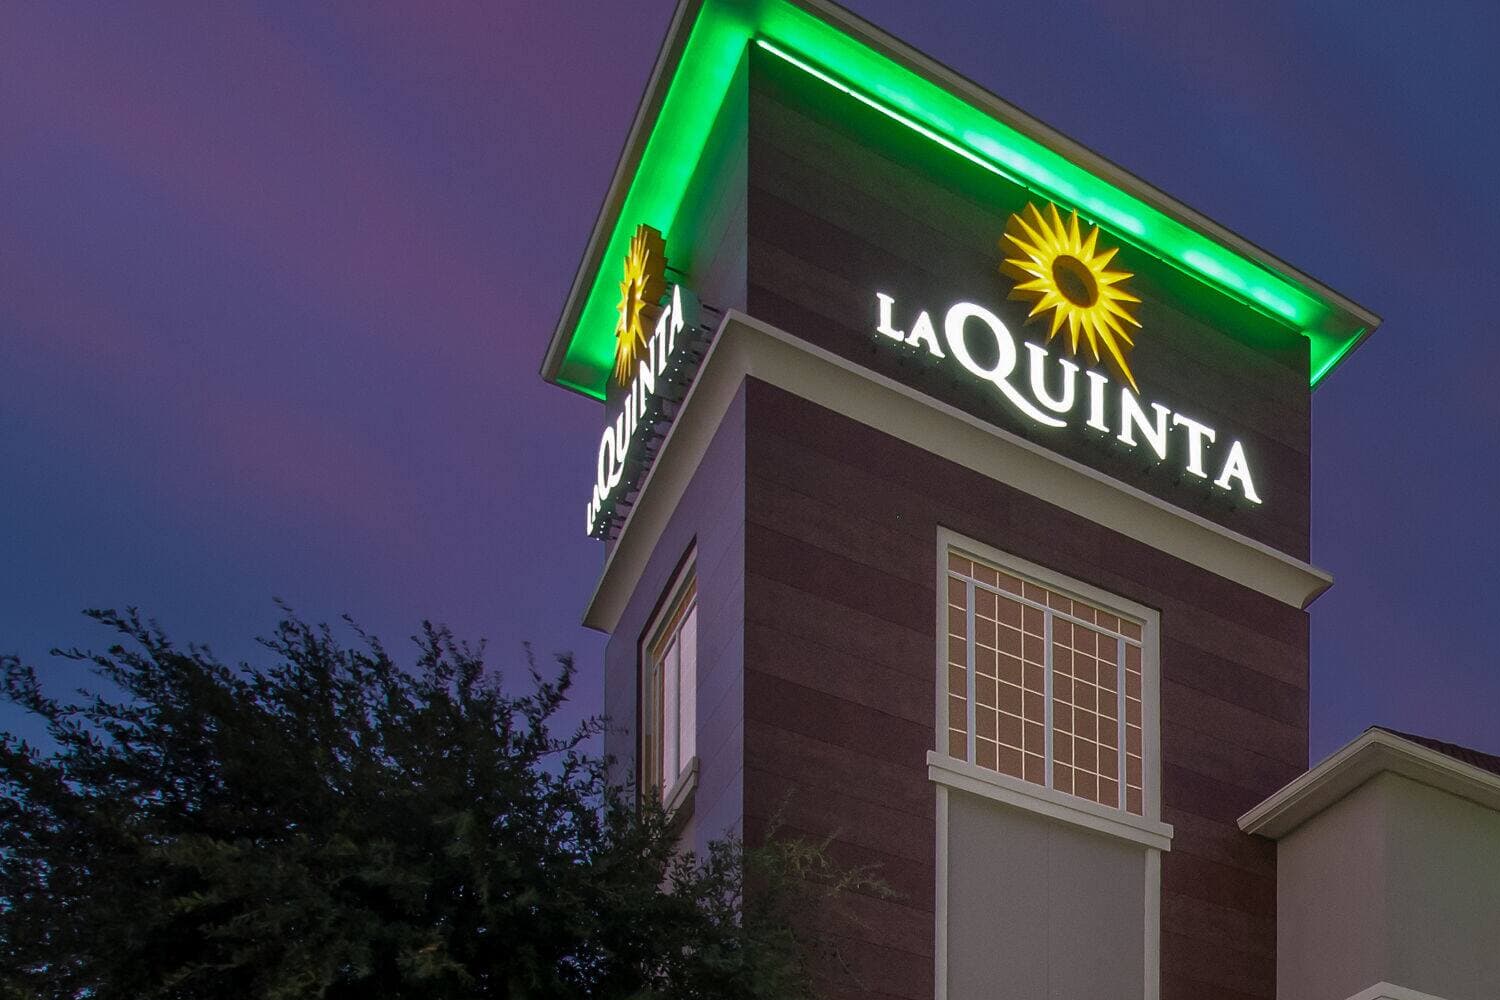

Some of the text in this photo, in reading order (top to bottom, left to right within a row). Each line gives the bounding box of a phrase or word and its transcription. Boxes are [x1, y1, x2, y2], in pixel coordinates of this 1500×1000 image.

[597, 283, 686, 501] QUINTA
[875, 291, 1263, 505] LA QUINTA
